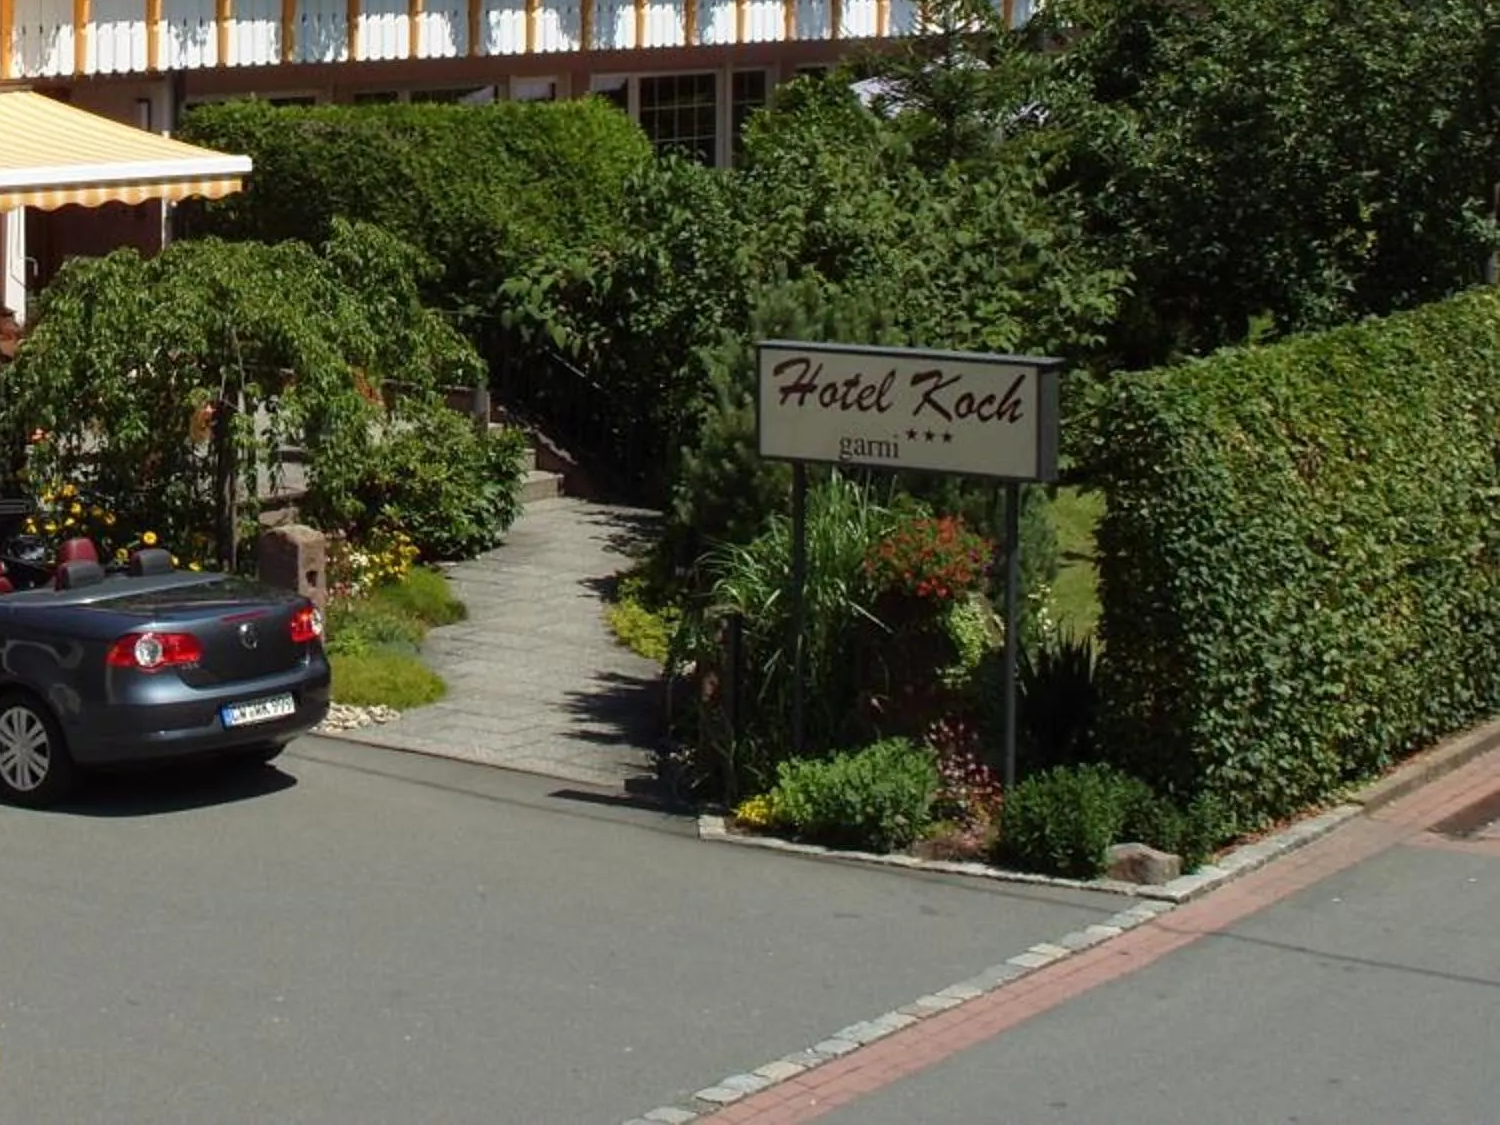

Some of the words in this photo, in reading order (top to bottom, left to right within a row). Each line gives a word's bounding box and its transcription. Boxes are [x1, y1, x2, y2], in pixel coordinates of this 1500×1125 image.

[772, 357, 897, 413] Hotel
[910, 369, 1026, 424] Koch
[838, 435, 900, 461] garni
